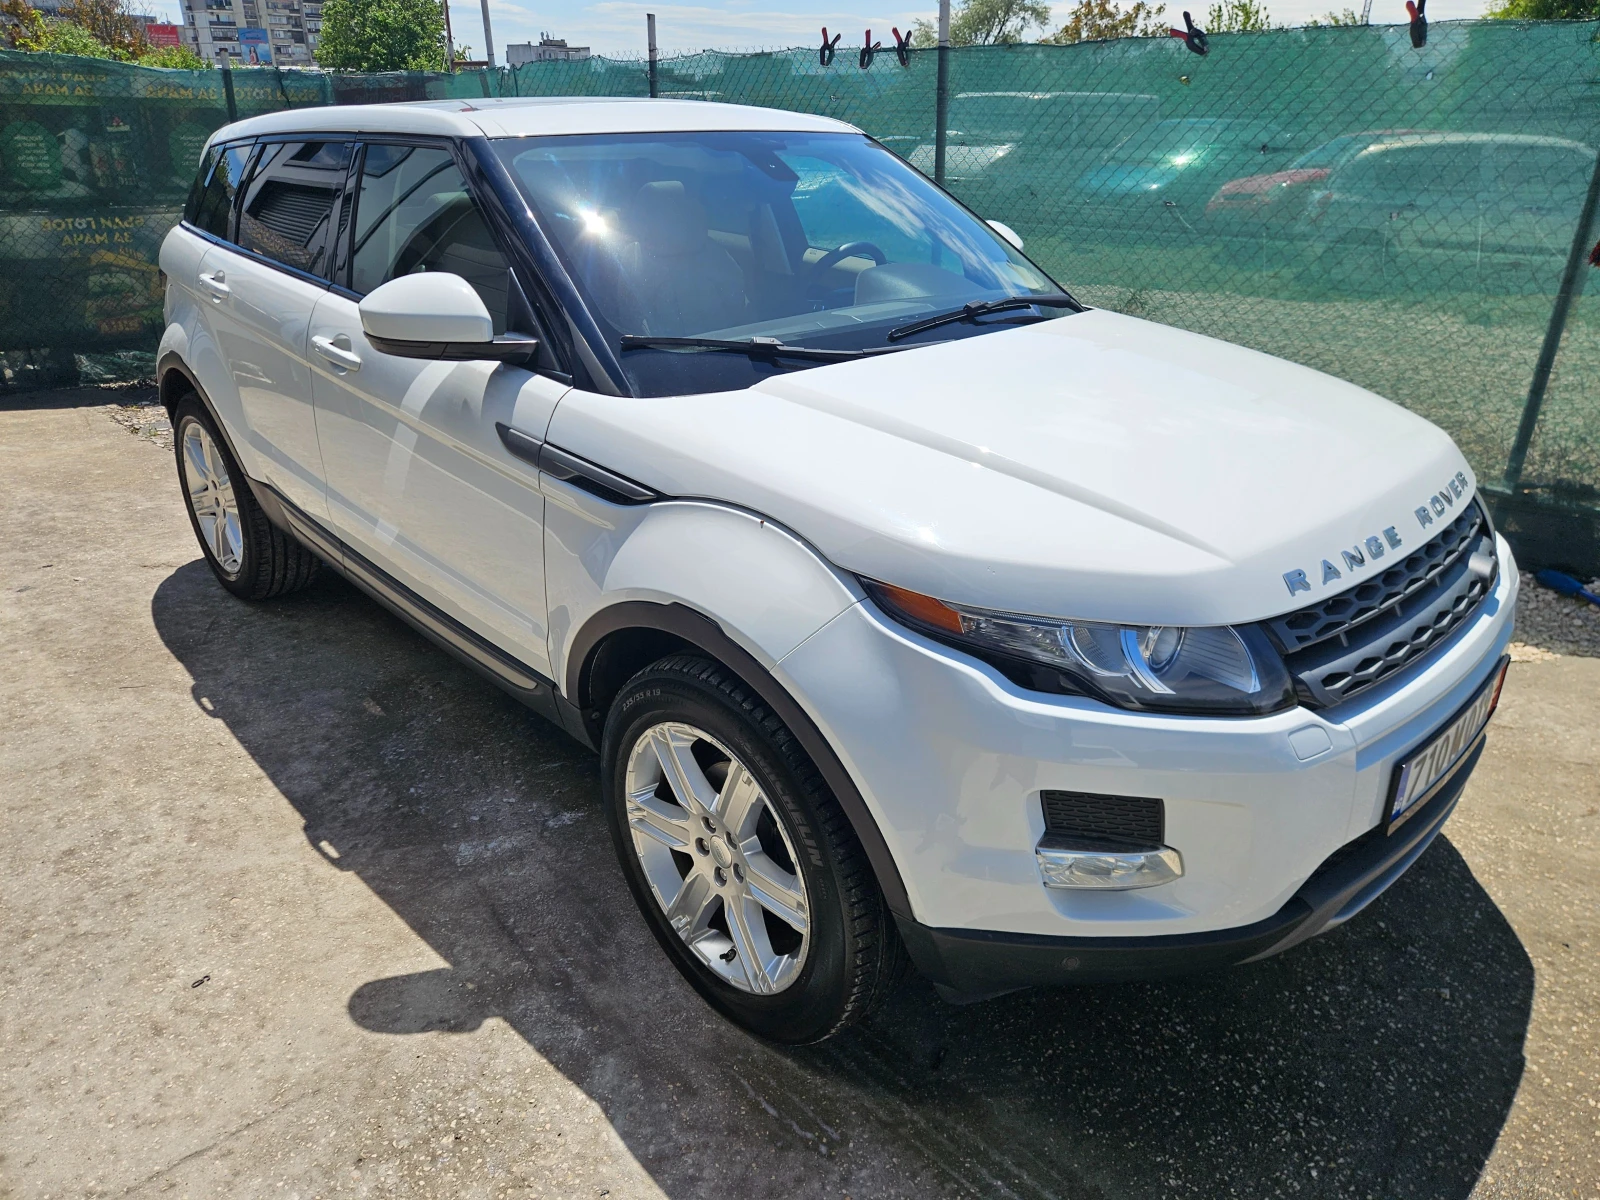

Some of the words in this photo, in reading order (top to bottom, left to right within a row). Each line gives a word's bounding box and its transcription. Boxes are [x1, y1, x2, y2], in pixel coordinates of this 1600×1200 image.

[1281, 525, 1403, 597] RANGE
[1413, 470, 1469, 529] ROVER
[652, 688, 661, 696] 19
